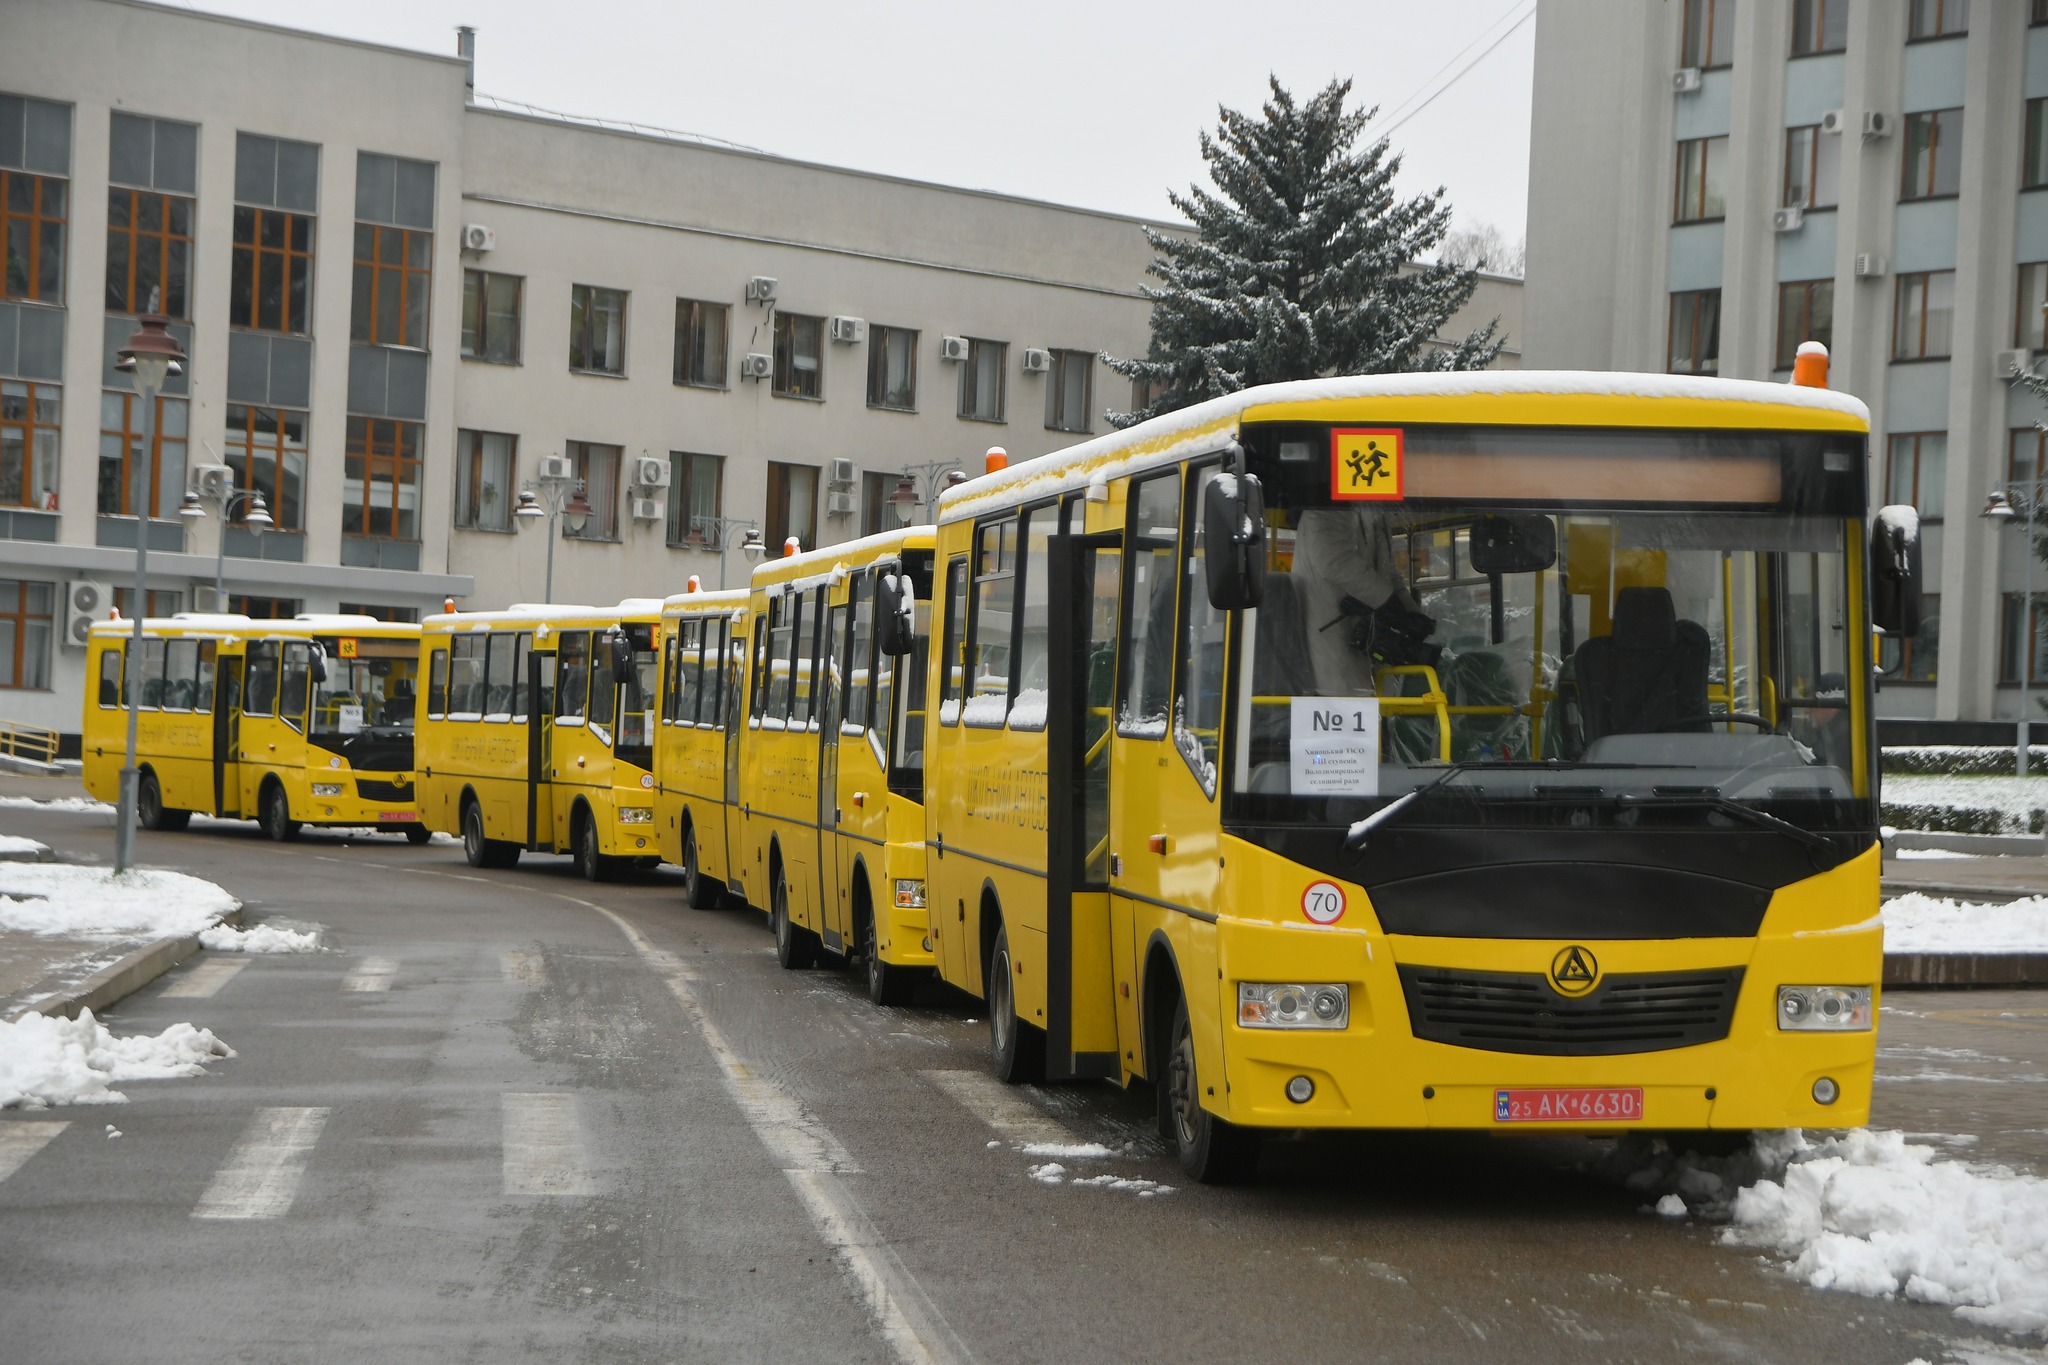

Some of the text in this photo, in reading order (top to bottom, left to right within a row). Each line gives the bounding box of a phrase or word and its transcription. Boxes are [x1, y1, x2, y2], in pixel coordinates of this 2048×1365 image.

[1352, 711, 1366, 732] 1
[643, 777, 653, 785] 70
[1311, 892, 1338, 912] 70
[1498, 1108, 1509, 1117] UA
[1511, 1101, 1532, 1117] 25
